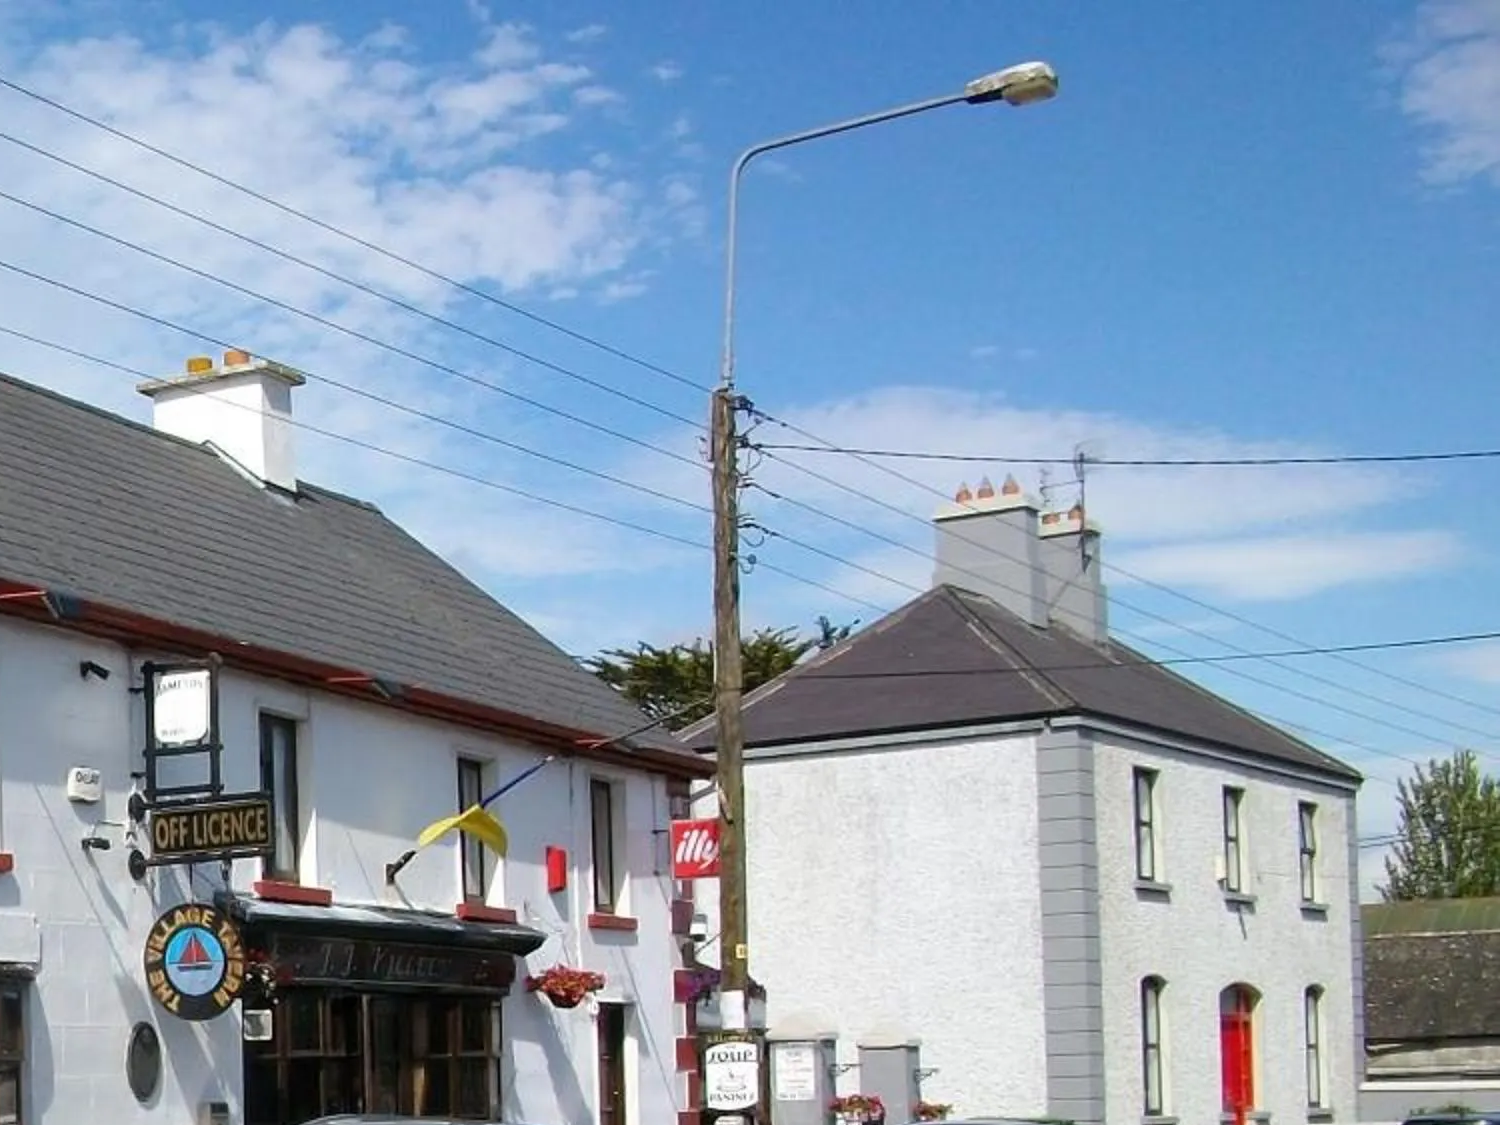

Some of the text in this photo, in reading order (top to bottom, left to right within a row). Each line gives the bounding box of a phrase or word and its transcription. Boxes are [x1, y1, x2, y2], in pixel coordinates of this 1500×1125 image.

[155, 807, 267, 849] OFF LICENCE
[675, 829, 719, 869] illy
[147, 907, 244, 1012] THE VILLAGE TAVERN
[708, 1049, 753, 1064] SOUP
